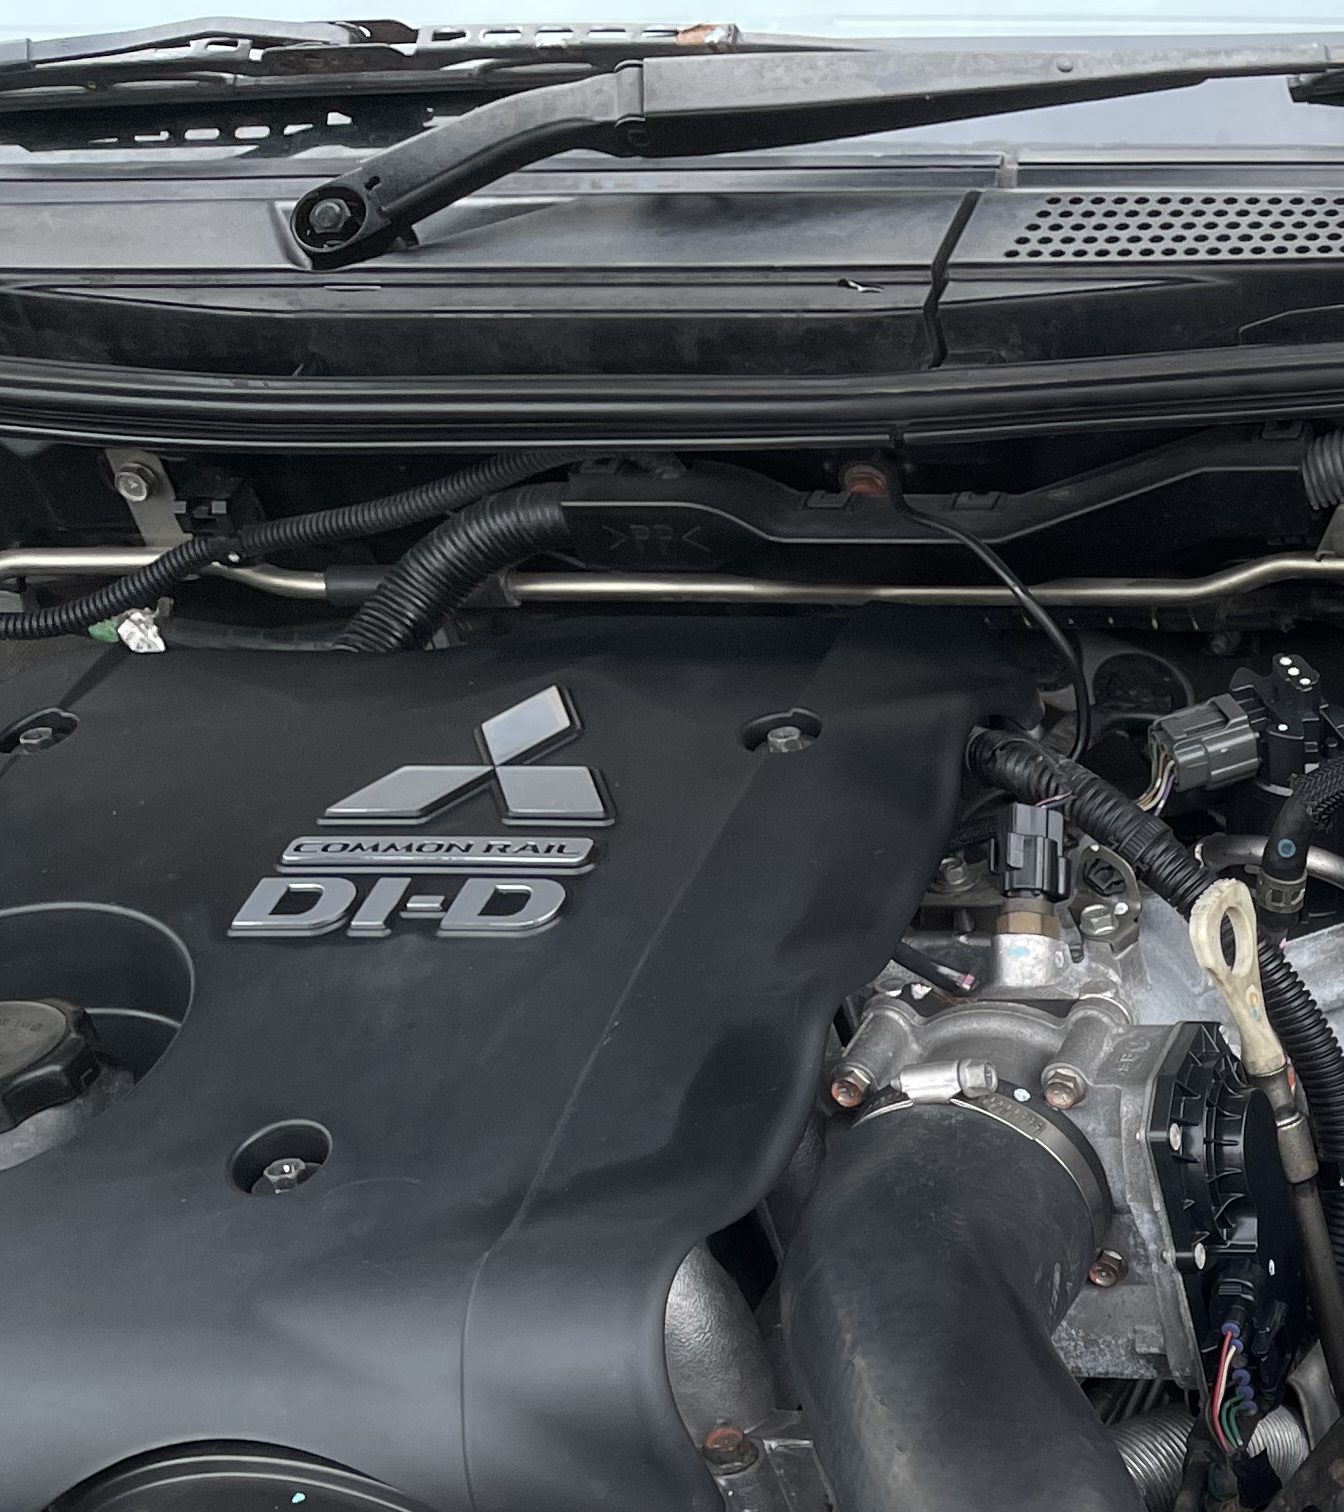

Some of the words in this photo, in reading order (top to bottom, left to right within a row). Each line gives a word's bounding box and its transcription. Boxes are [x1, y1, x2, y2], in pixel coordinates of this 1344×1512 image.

[293, 842, 474, 854] COMMON
[482, 841, 582, 855] RAIL
[229, 877, 567, 935] DI-D
